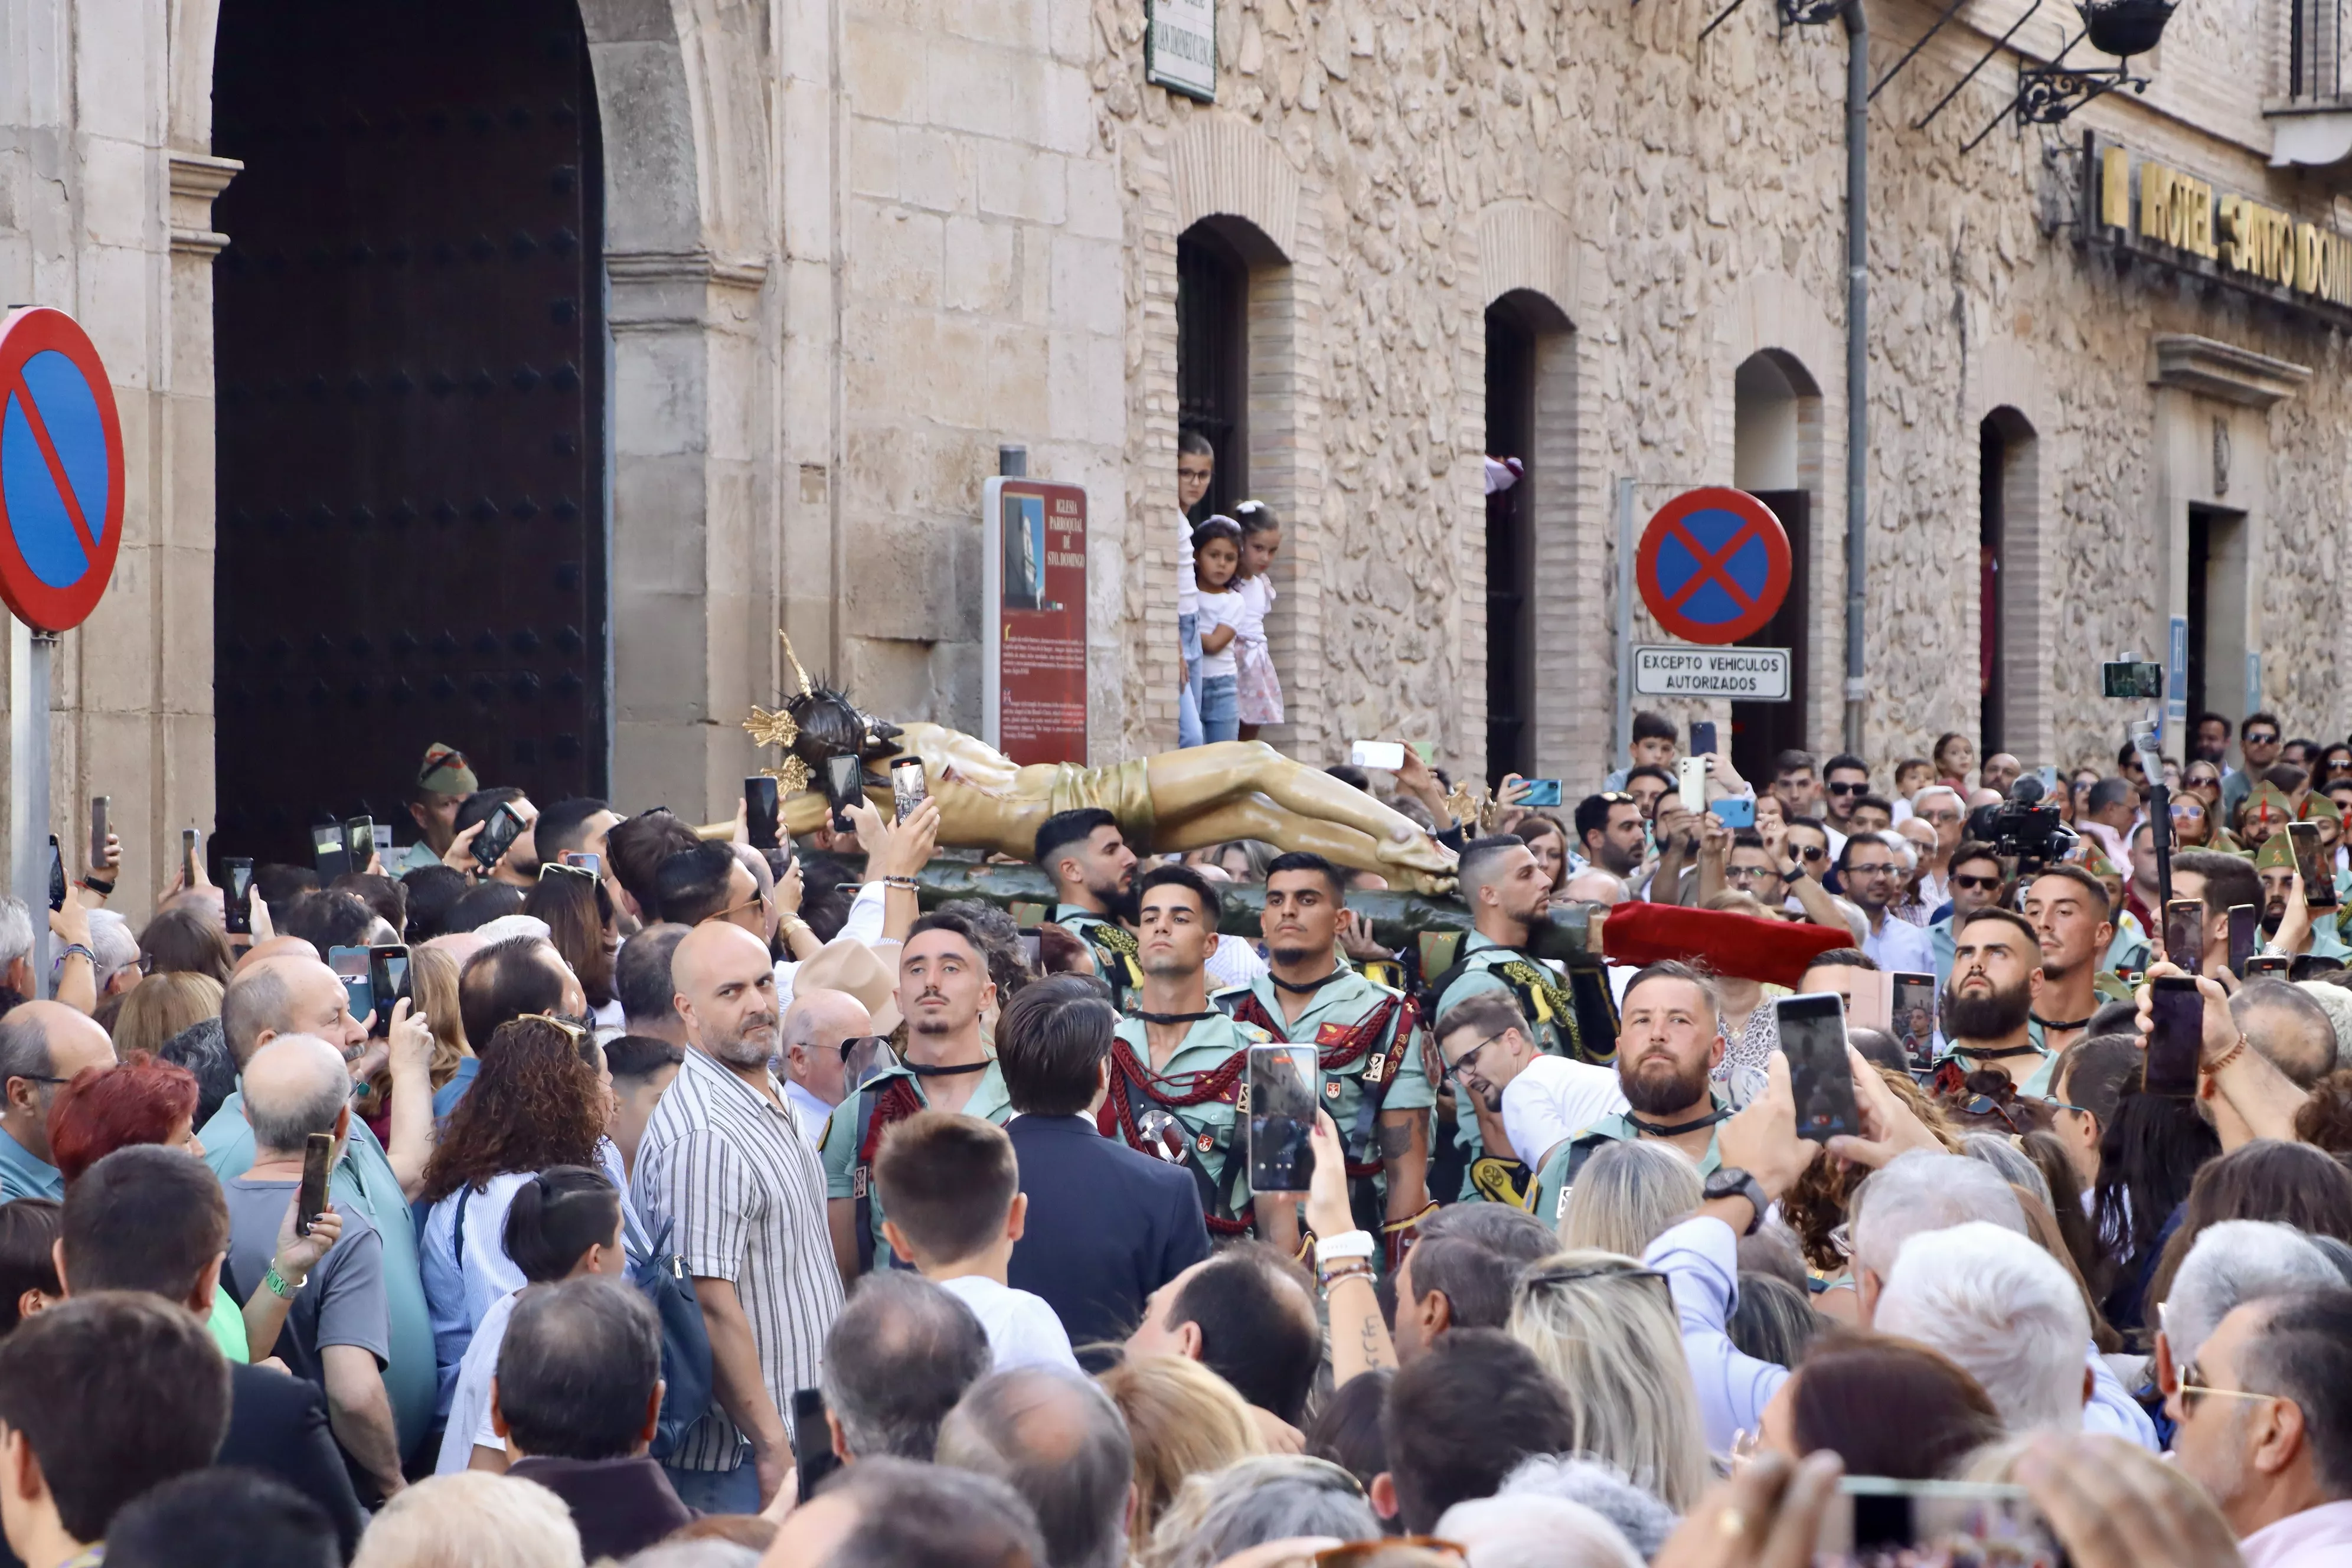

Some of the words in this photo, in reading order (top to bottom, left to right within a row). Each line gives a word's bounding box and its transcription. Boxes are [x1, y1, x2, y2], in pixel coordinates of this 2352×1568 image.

[2141, 161, 2219, 260] HOTEL
[2219, 194, 2295, 290] SANTO
[1056, 498, 1077, 515] IGLESIA
[1049, 515, 1083, 534] PARROQUIAL
[1063, 535, 1072, 550] DE
[1047, 551, 1060, 566] STO.
[1060, 553, 1084, 569] DOMINGO
[2175, 626, 2183, 672] H
[1644, 655, 1703, 669] EXCEPTO
[1710, 657, 1779, 672] VEHICULOS
[1667, 675, 1757, 691] AUTORIZADOS
